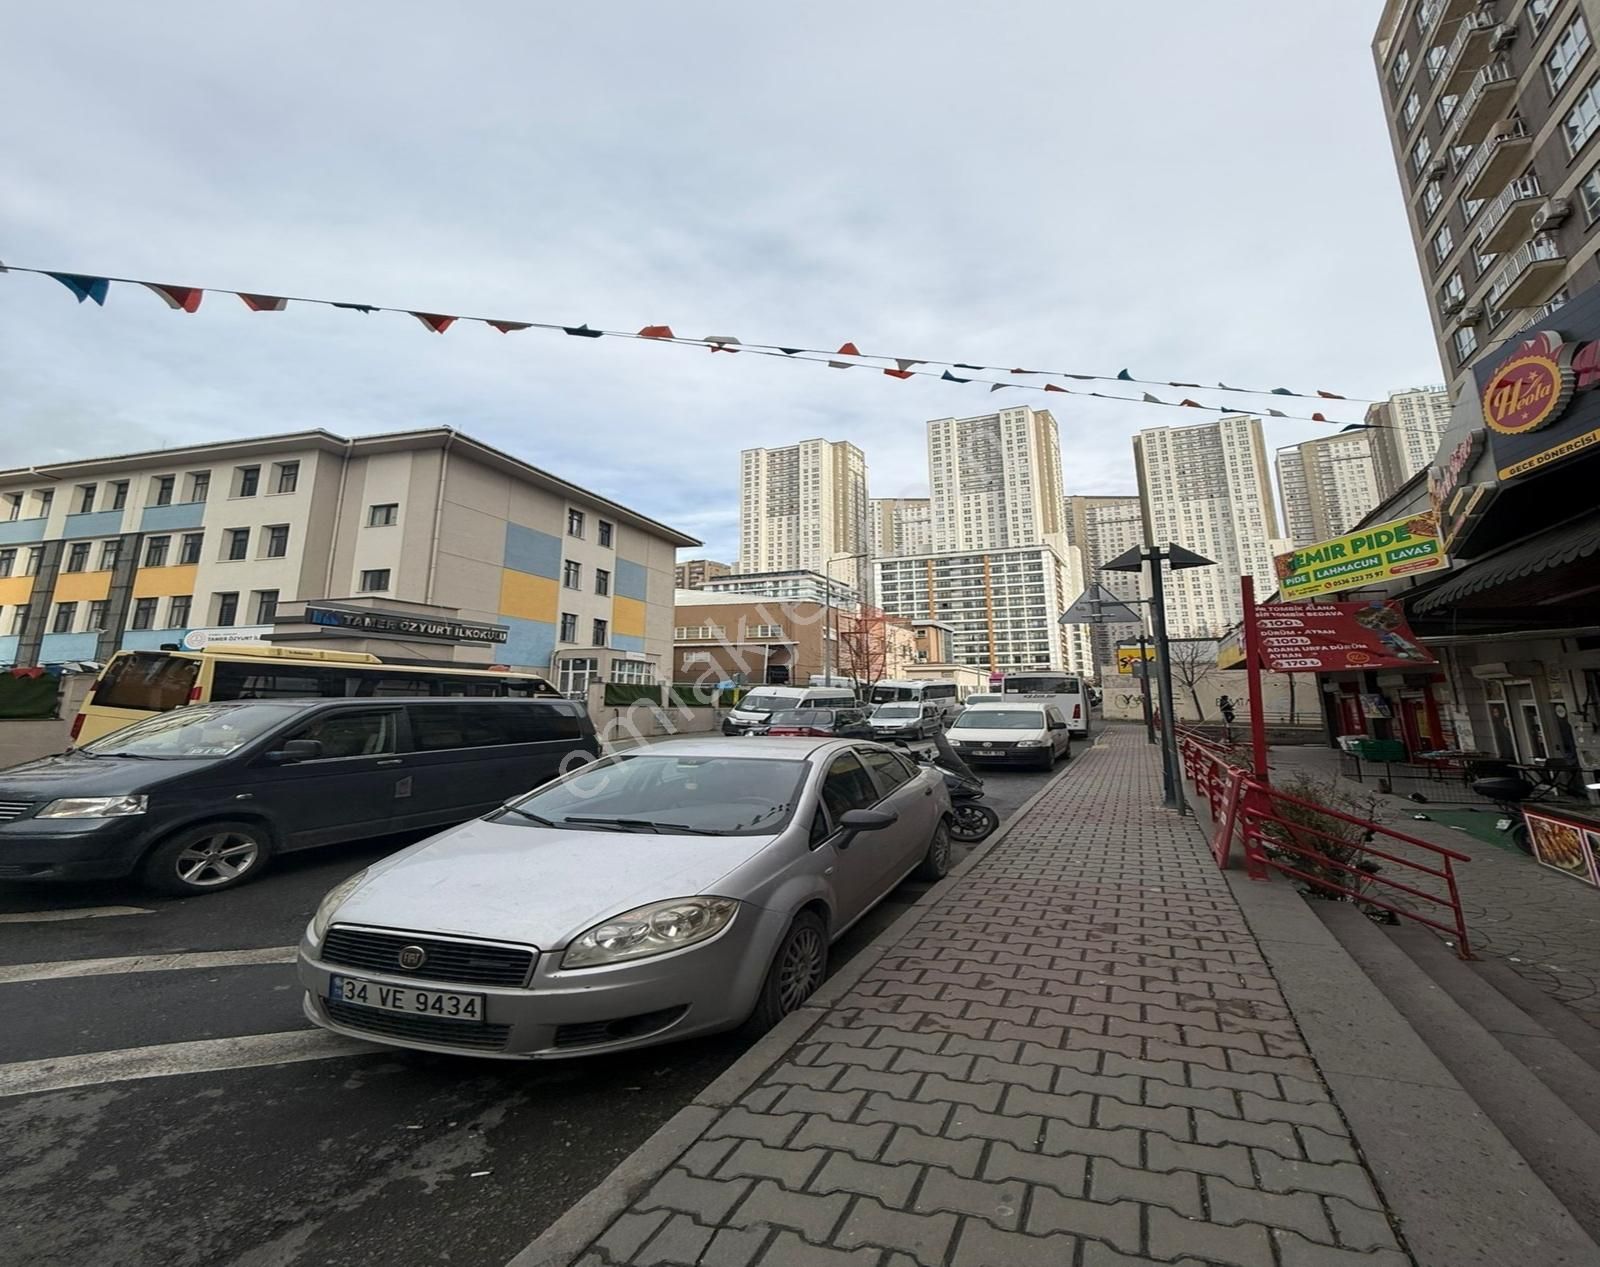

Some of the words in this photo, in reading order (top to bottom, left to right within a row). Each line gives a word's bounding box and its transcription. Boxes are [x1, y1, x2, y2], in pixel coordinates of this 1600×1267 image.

[1494, 378, 1552, 421] Heola
[1509, 460, 1535, 475] GECE
[1316, 557, 1378, 579] LAHMACUN
[343, 614, 396, 630] TAMER
[400, 618, 453, 635] ÖZYURT
[344, 981, 368, 1003] 34
[379, 987, 405, 1009] VE
[416, 993, 477, 1018] 9434
